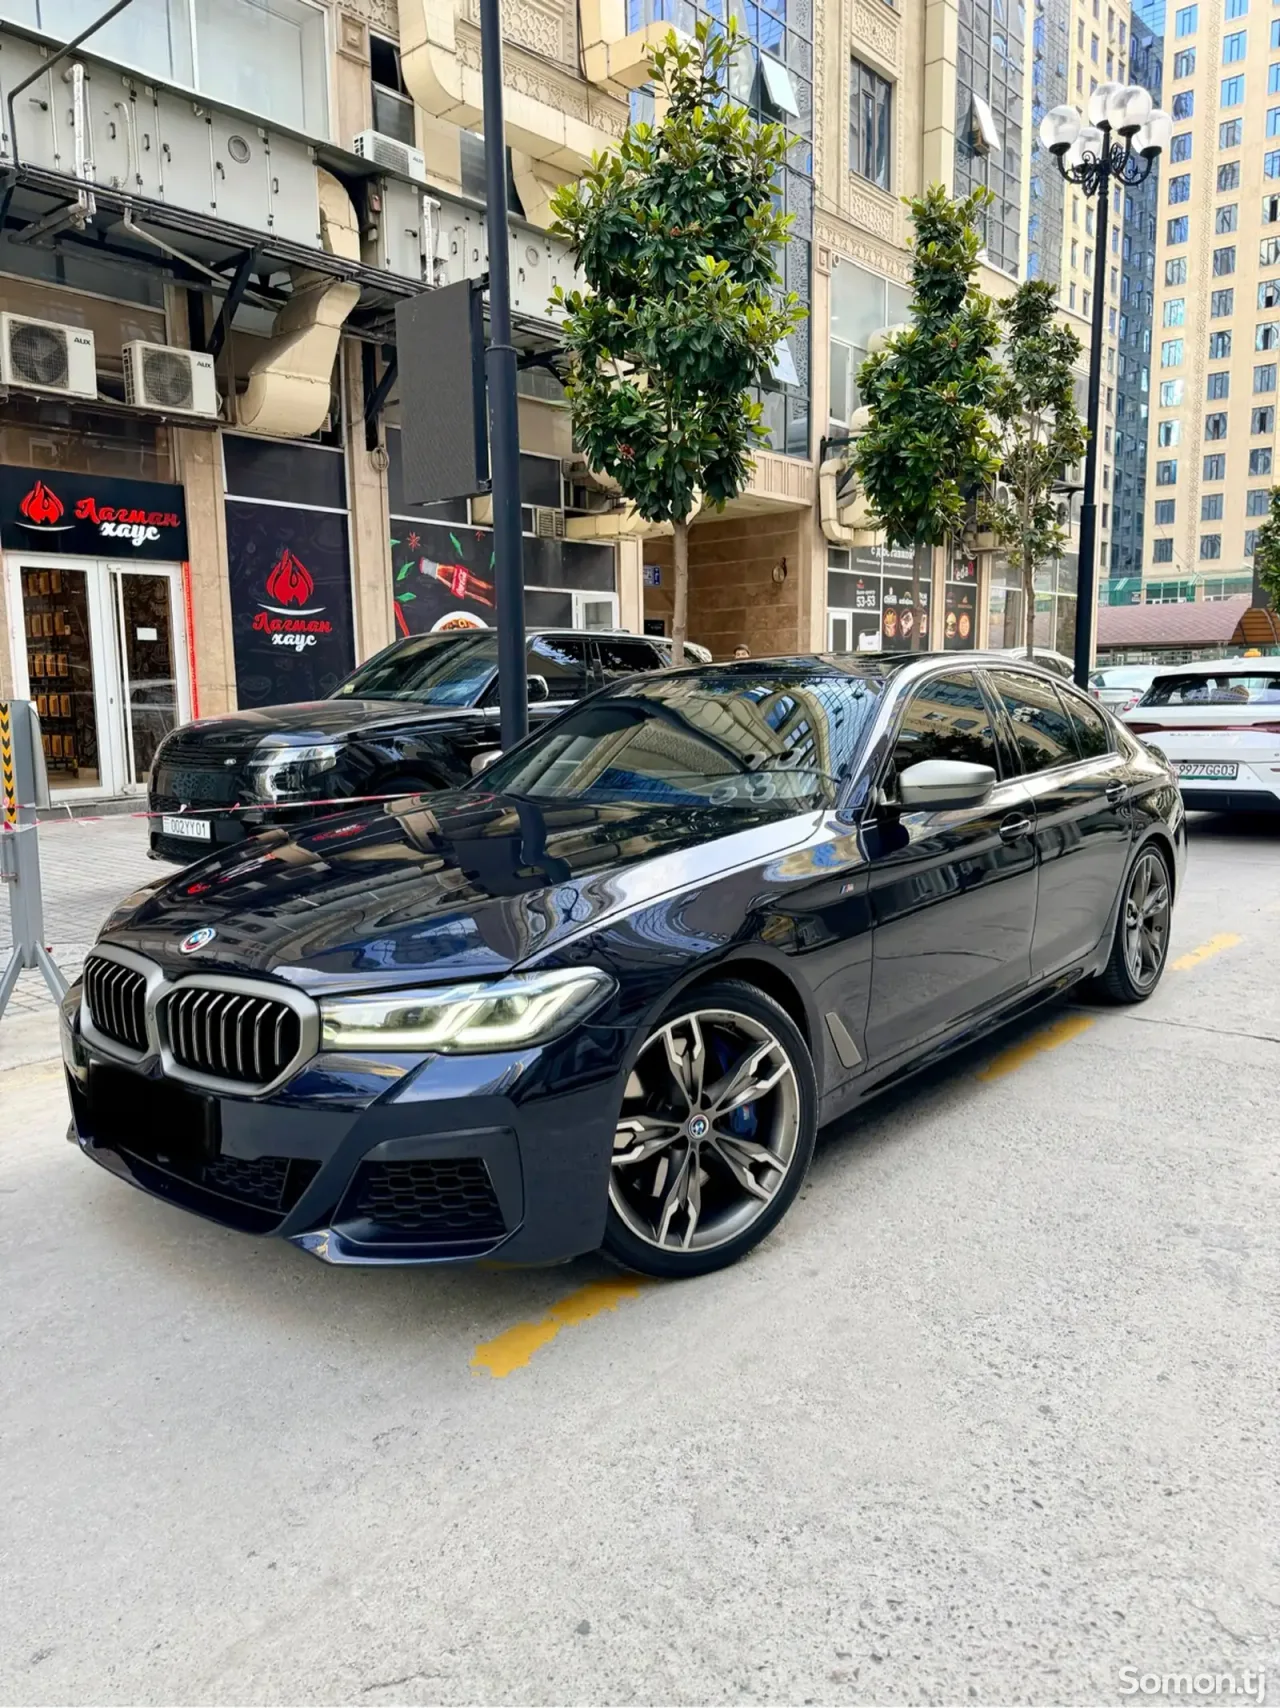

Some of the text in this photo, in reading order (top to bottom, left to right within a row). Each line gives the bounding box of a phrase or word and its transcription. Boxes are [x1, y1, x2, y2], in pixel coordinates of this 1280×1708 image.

[73, 336, 92, 346] AUX
[196, 360, 213, 370] AUX
[74, 497, 181, 528] Лагман
[99, 521, 161, 547] хаус
[856, 595, 876, 608] 53-53
[252, 611, 333, 635] Лагман
[271, 632, 318, 653] хаус
[1178, 763, 1236, 777] 9977GG03
